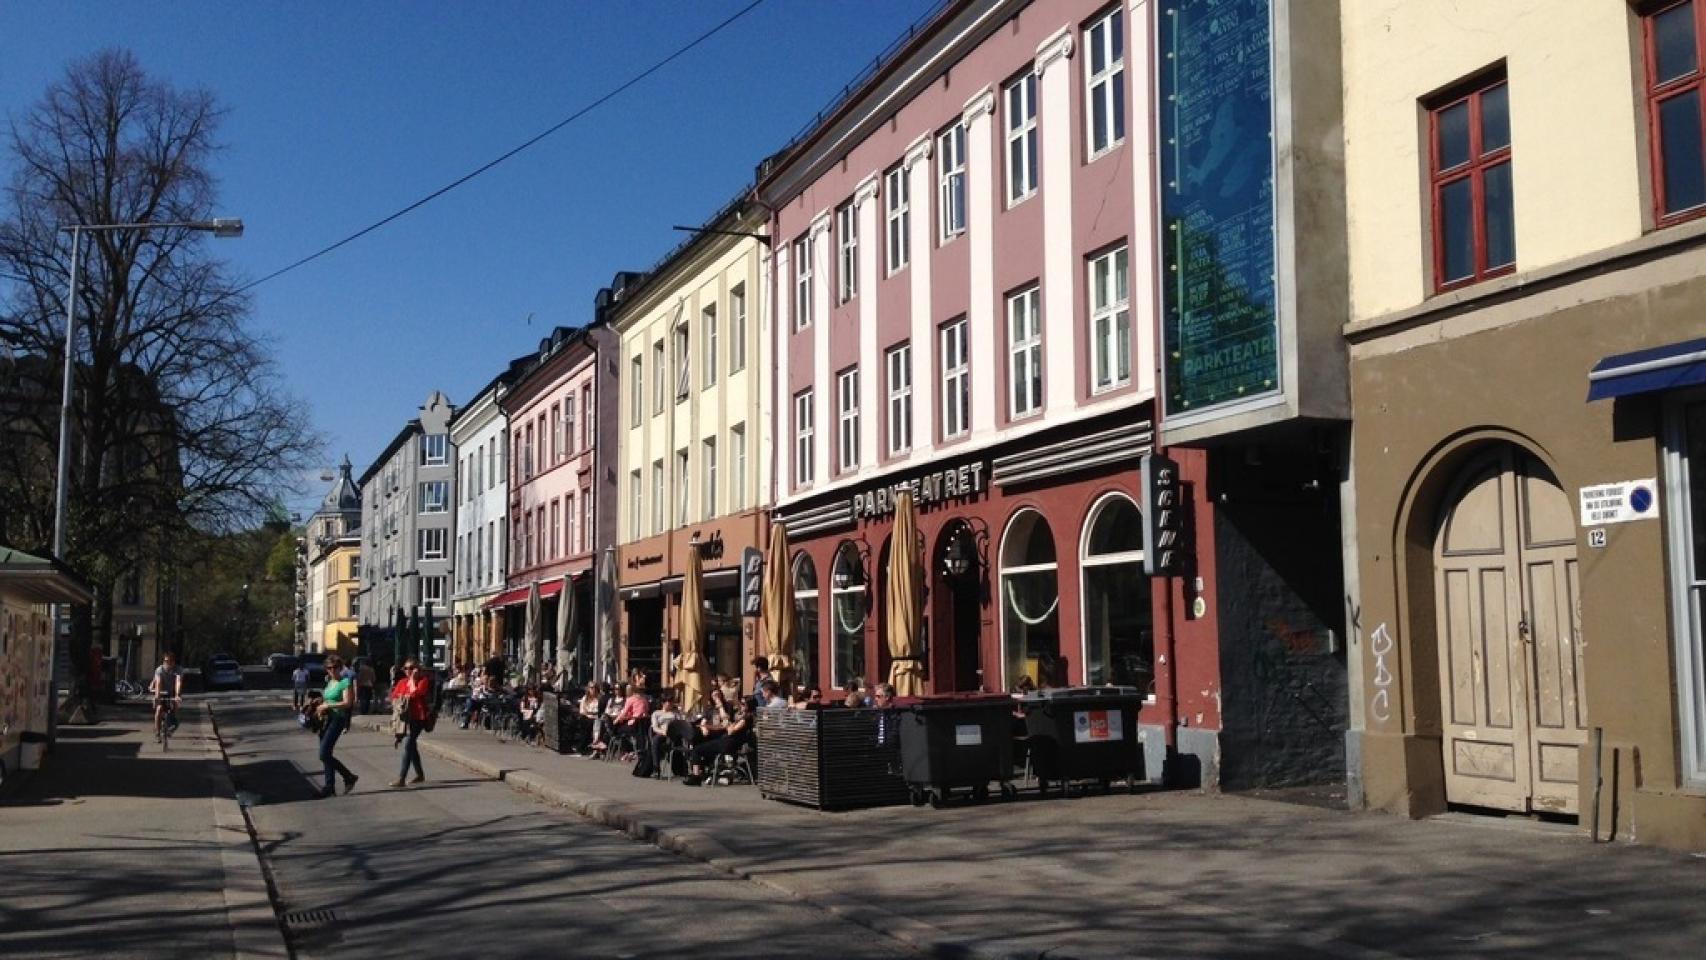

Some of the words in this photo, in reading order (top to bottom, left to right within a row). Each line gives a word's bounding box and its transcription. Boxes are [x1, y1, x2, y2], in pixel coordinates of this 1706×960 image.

[854, 461, 983, 519] PARKEATRET
[1590, 531, 1604, 546] 12
[746, 555, 761, 612] BAR
